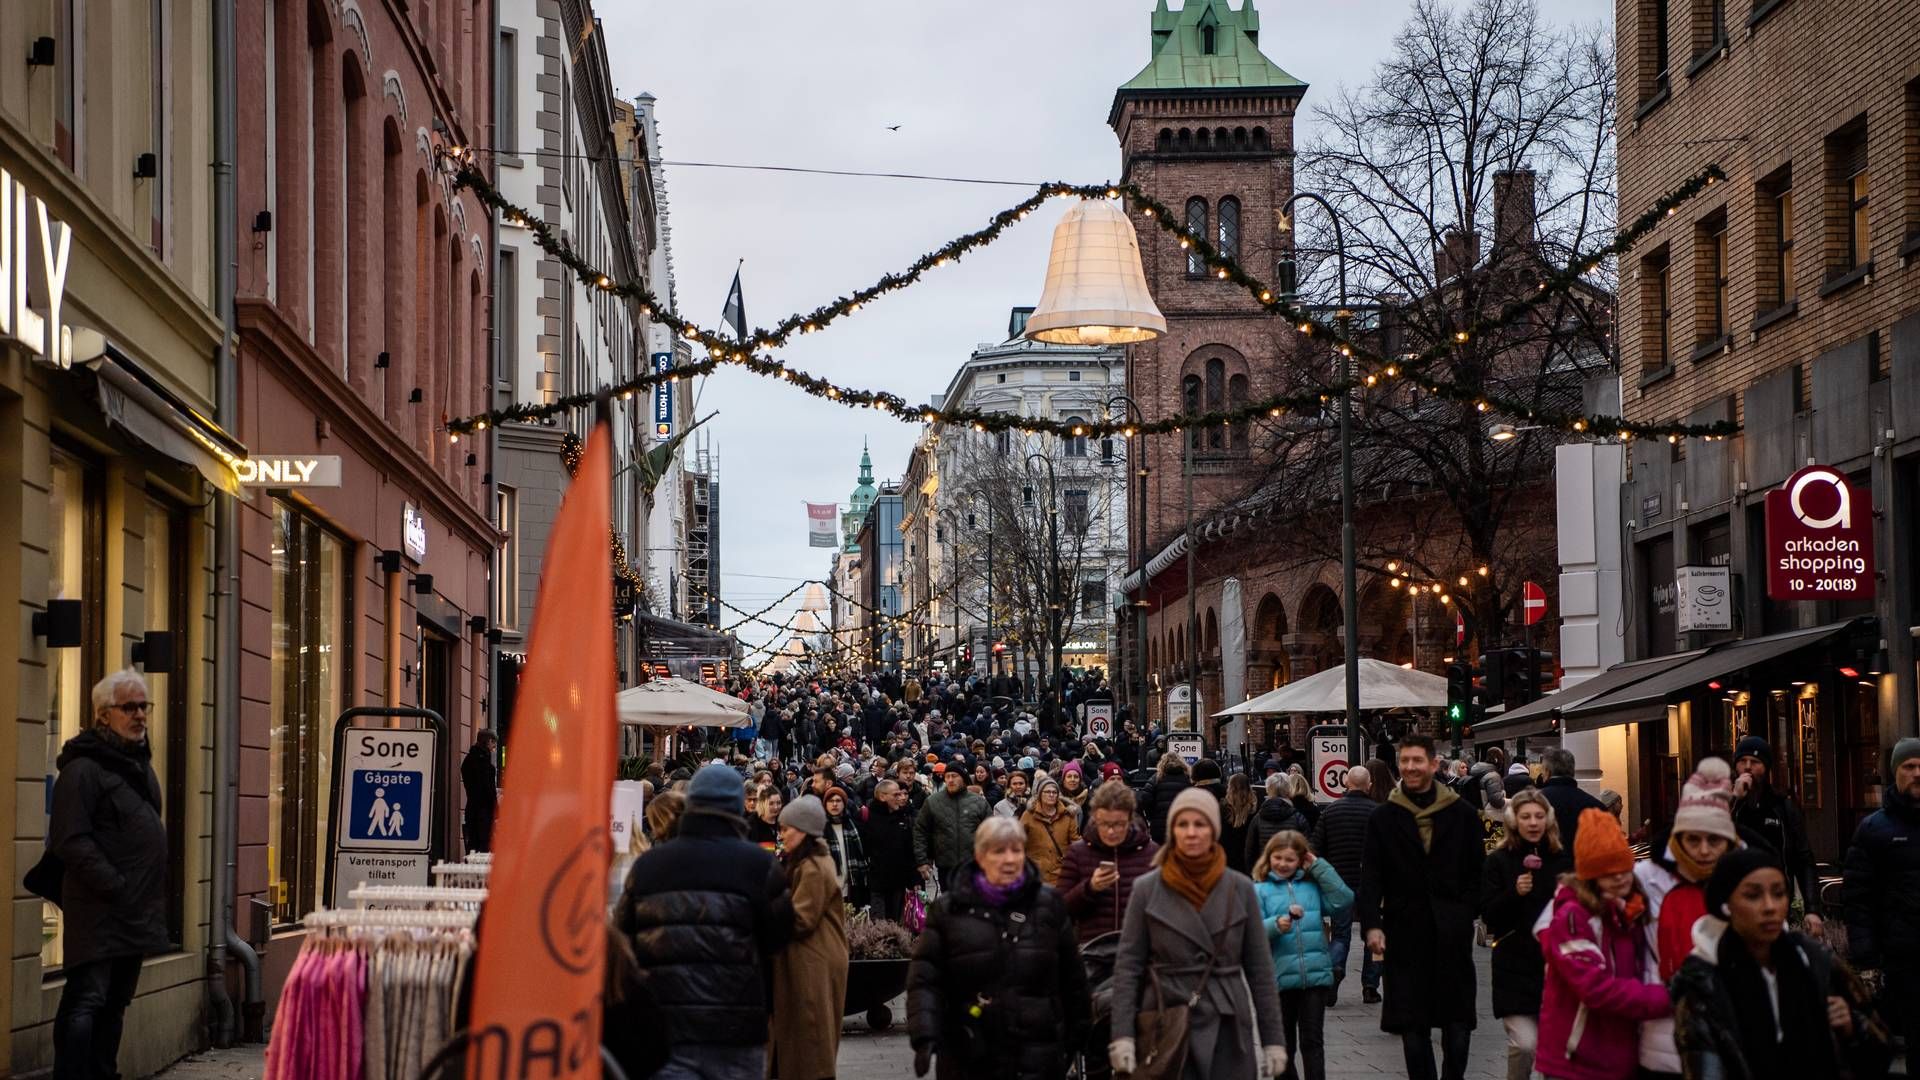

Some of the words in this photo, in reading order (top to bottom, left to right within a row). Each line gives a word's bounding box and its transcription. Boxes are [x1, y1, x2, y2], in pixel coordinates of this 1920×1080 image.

[231, 459, 318, 482] ONLY
[1785, 536, 1859, 552] arkaden
[1780, 554, 1865, 574] shopping
[1789, 579, 1804, 591] 10
[1815, 578, 1857, 591] 20(18)
[1093, 722, 1106, 732] 30
[360, 736, 419, 758] Sone
[1174, 744, 1197, 752] Sone
[1321, 741, 1347, 753] Son
[364, 772, 411, 787] Gågate
[349, 856, 416, 868] Varetransport
[368, 871, 396, 880] tillatt
